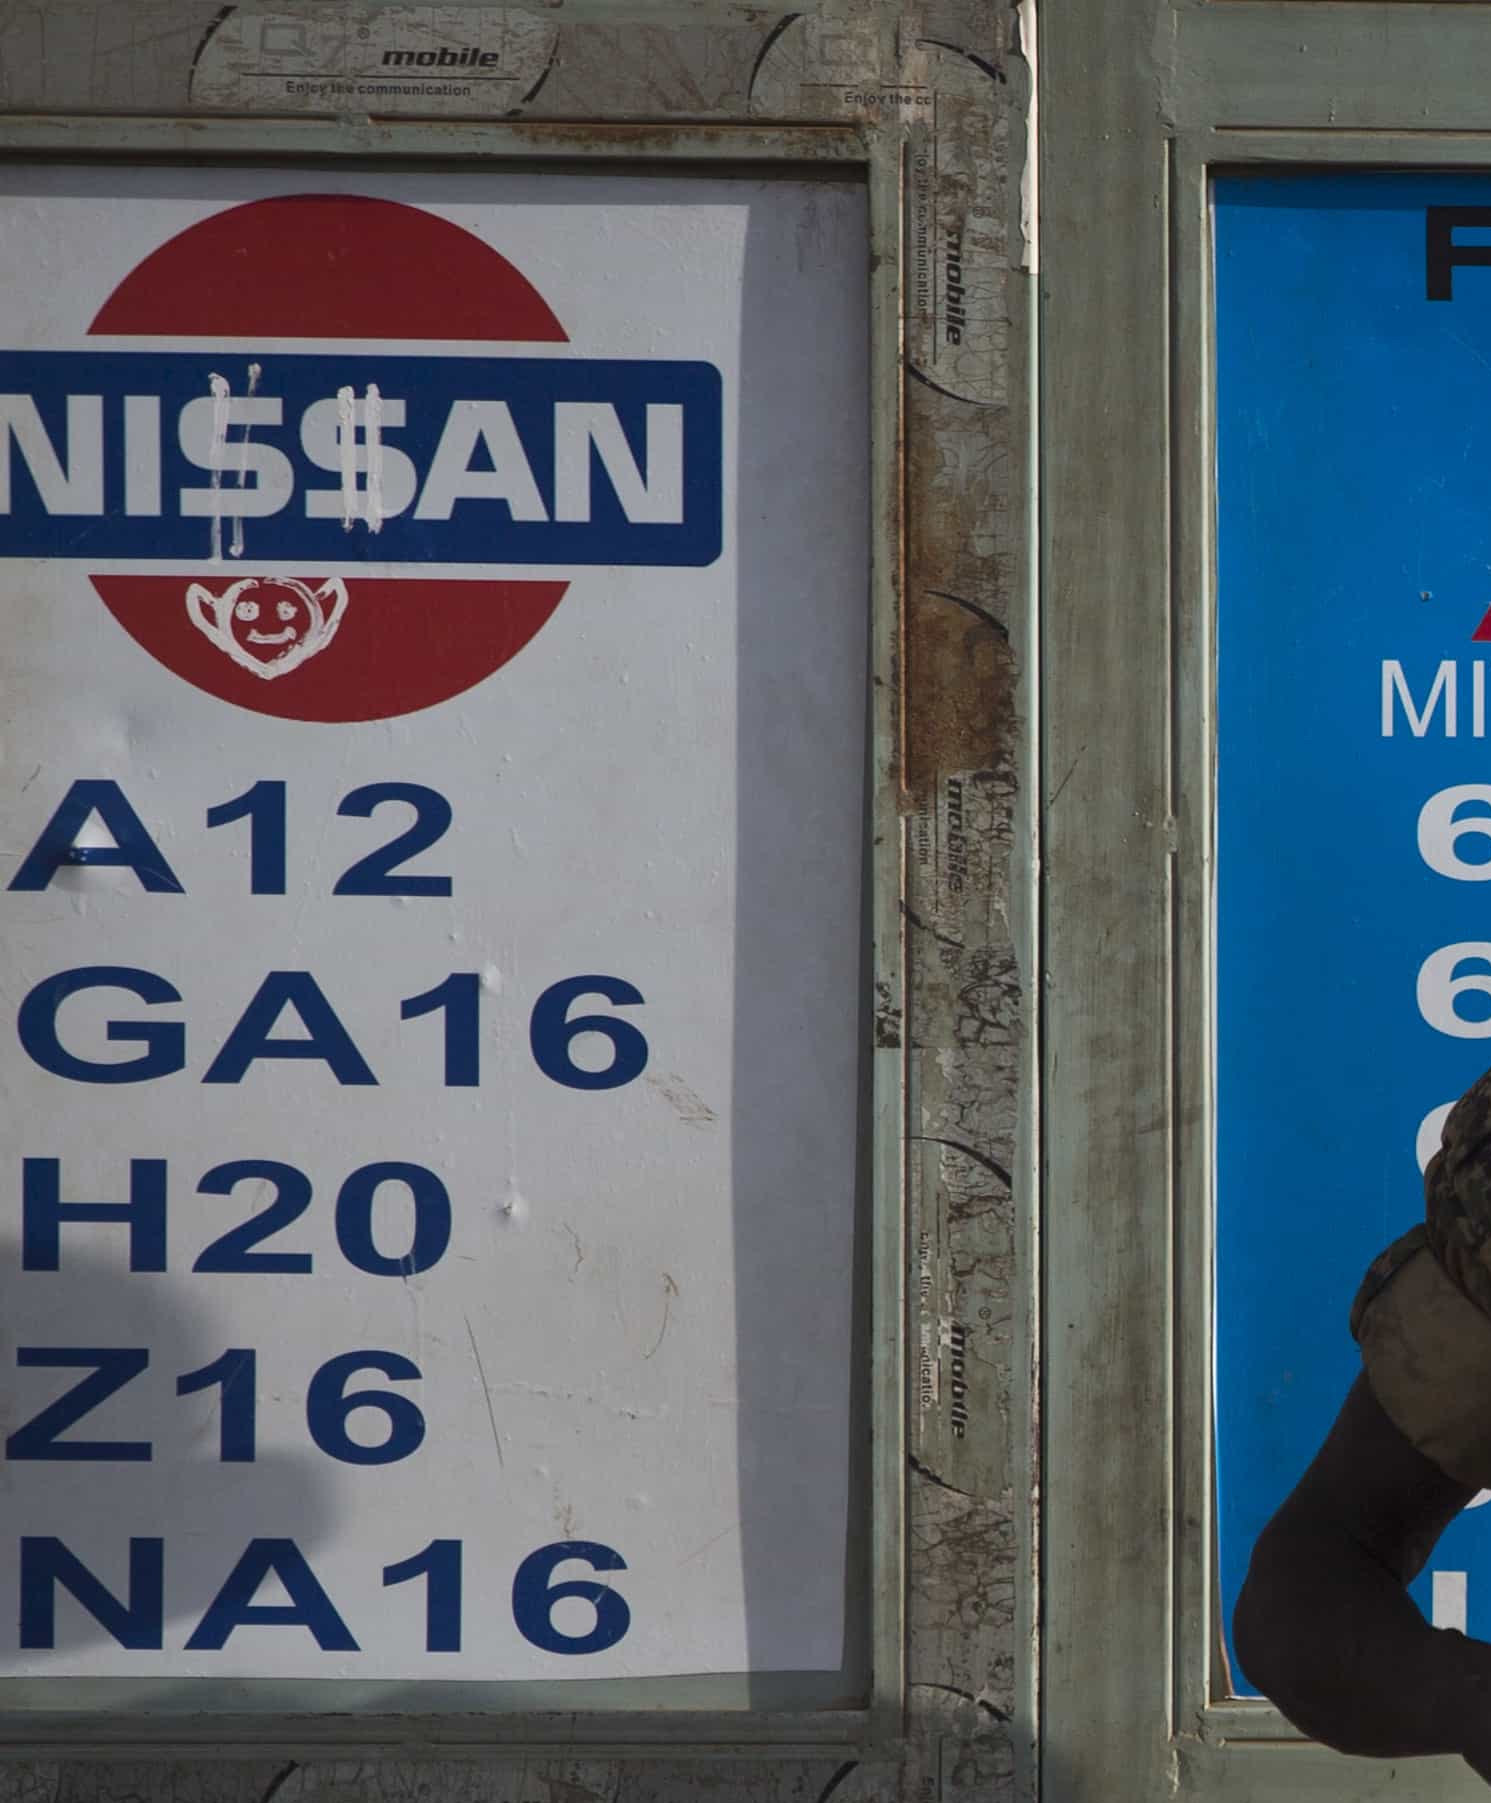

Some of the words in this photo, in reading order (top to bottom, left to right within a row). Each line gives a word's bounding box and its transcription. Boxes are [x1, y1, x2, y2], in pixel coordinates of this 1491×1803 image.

[285, 80, 327, 97] Enjoy
[357, 83, 471, 97] communication
[381, 48, 499, 67] mobile
[8, 779, 453, 897] A12
[17, 966, 649, 1090] GA16
[21, 1158, 452, 1277] H20
[6, 1347, 424, 1465] Z16
[19, 1537, 632, 1655] NA16
